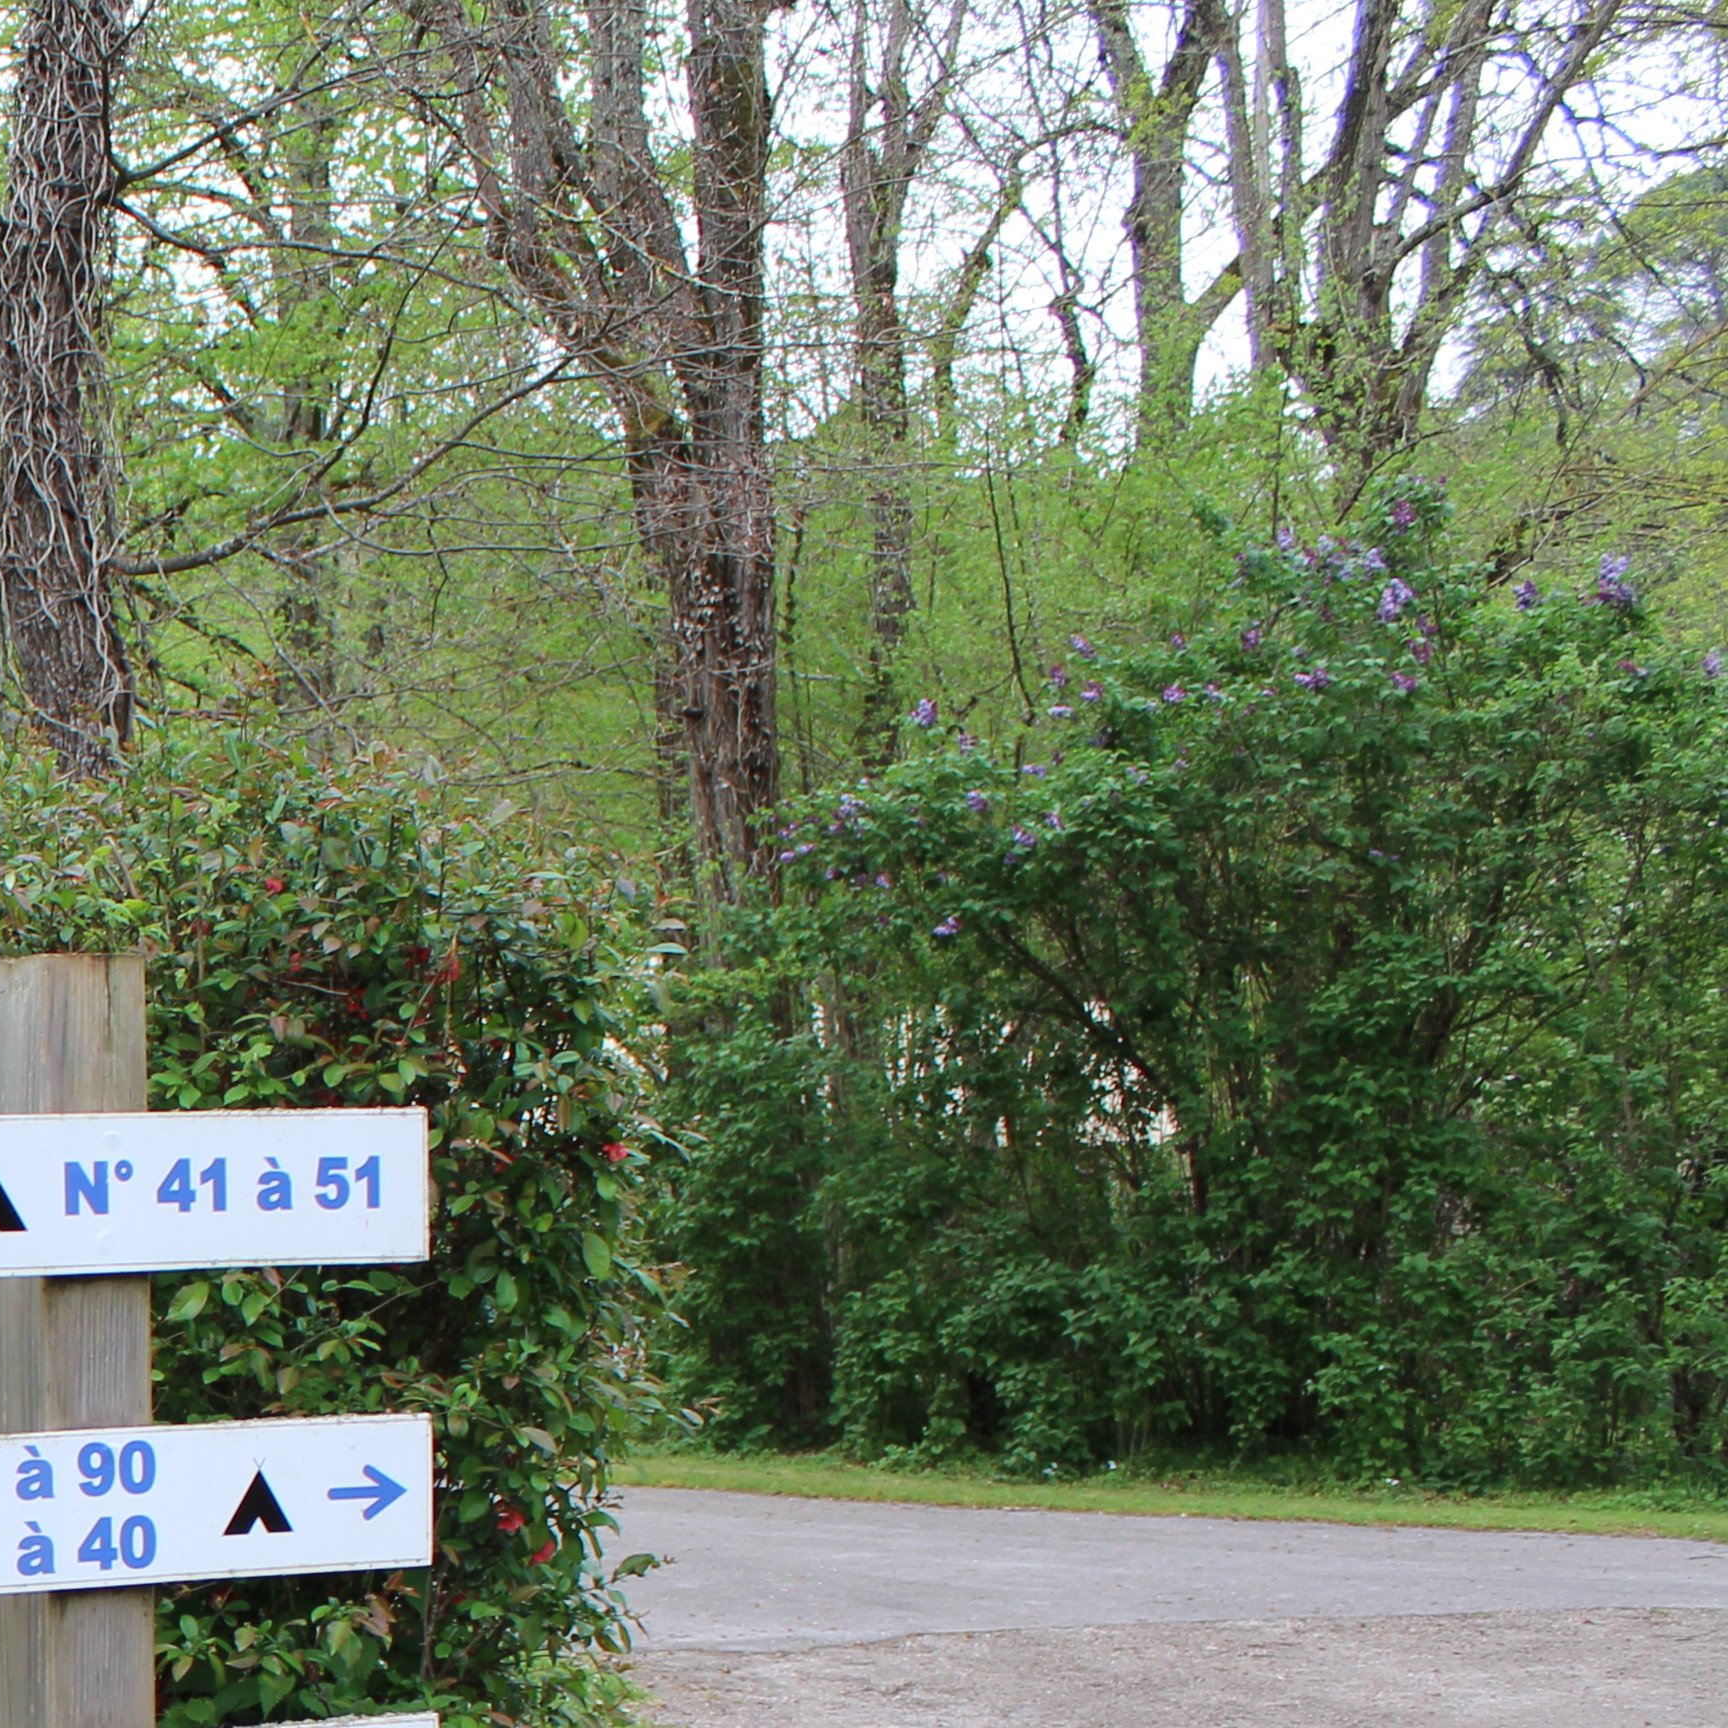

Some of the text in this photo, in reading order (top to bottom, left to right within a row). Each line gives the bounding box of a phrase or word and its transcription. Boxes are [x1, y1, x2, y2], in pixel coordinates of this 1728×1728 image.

[64, 1154, 382, 1216] N° 41 à 51
[16, 1444, 56, 1502] à
[78, 1439, 158, 1497] 90
[17, 1519, 57, 1577] à
[78, 1514, 158, 1571] 40
